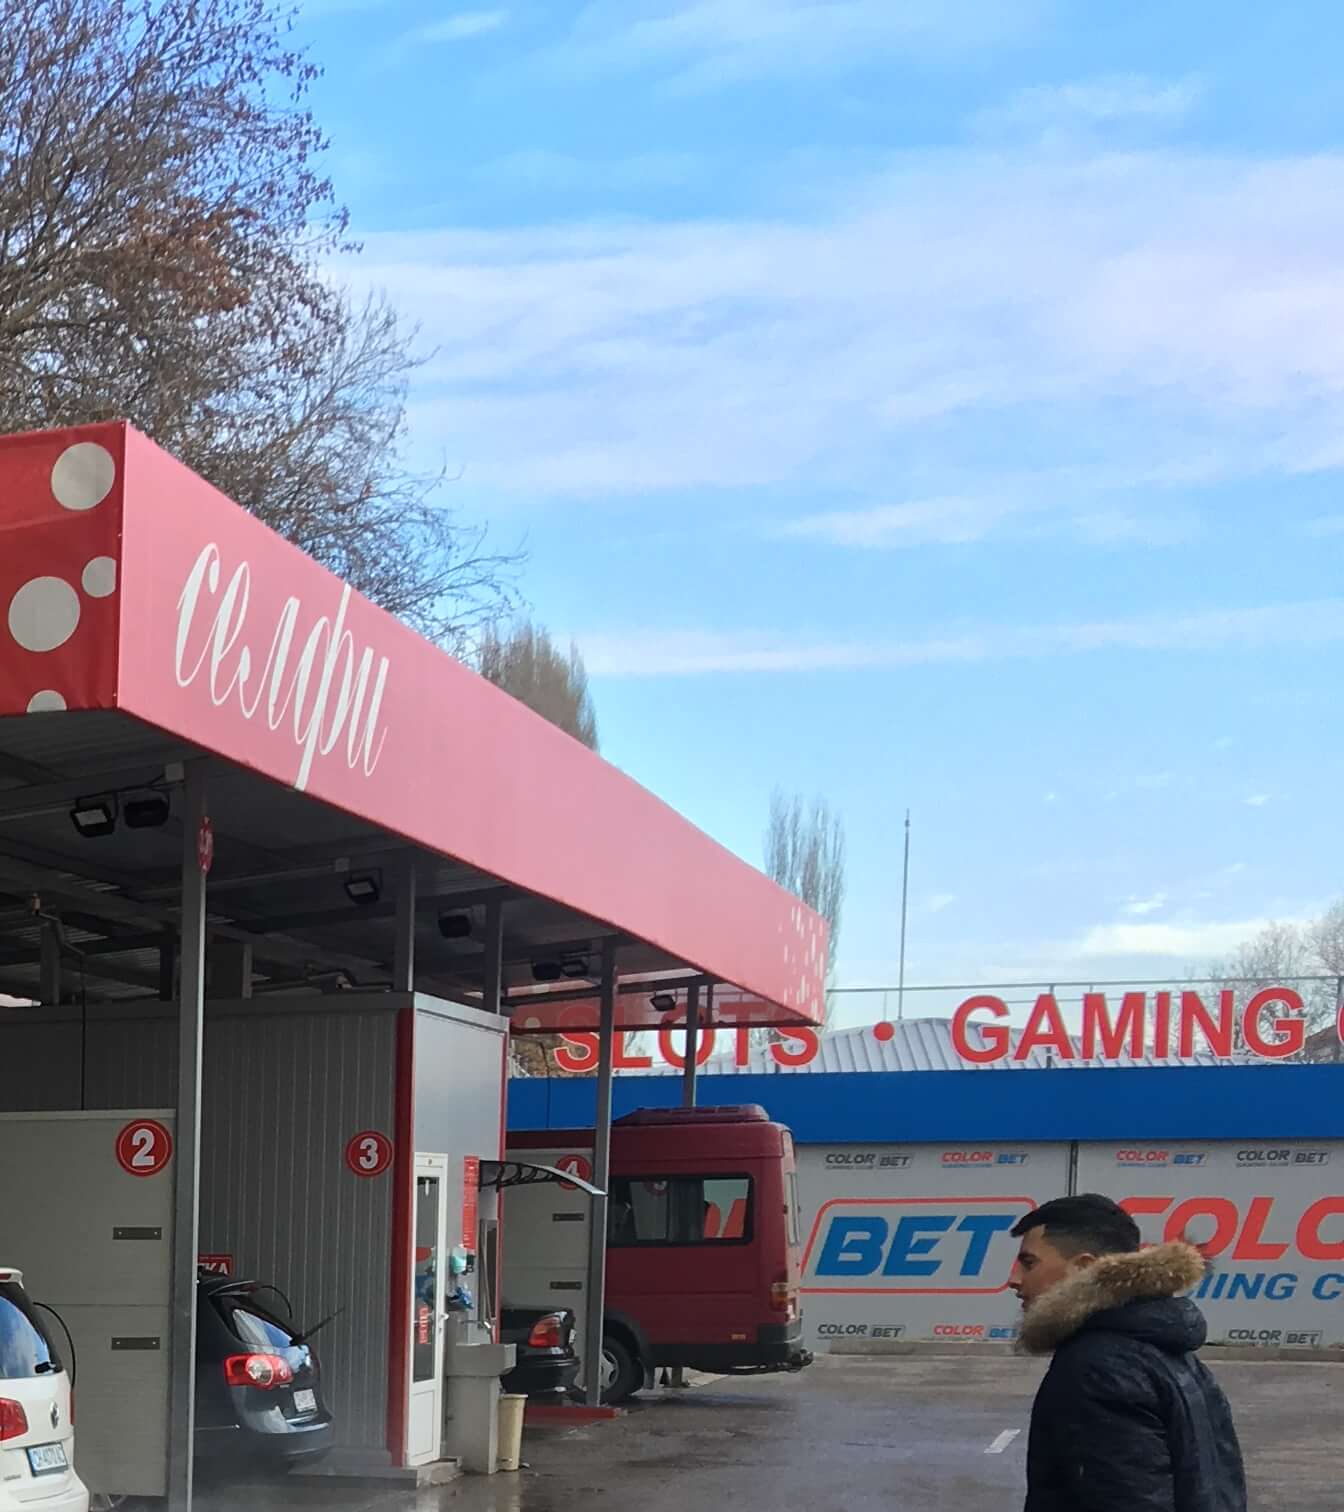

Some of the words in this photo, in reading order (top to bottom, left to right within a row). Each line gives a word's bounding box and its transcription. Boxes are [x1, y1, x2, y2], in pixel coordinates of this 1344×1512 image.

[951, 987, 1307, 1064] GAMING
[132, 1128, 155, 1166] 2
[359, 1138, 378, 1169] 3
[825, 1153, 876, 1165] COLOR
[879, 1155, 911, 1167] BET
[941, 1152, 993, 1163] COLOR
[997, 1153, 1029, 1165] BET
[1116, 1151, 1169, 1162] COLOR
[1173, 1153, 1205, 1165] BET
[1236, 1151, 1290, 1162] COLOR
[1294, 1152, 1329, 1164] BET
[814, 1215, 1017, 1277] BET
[817, 1324, 868, 1335] COLOR
[872, 1327, 902, 1338] BET
[933, 1325, 985, 1336] COLOR
[1228, 1329, 1282, 1341] COLOR
[1286, 1332, 1319, 1345] BET
